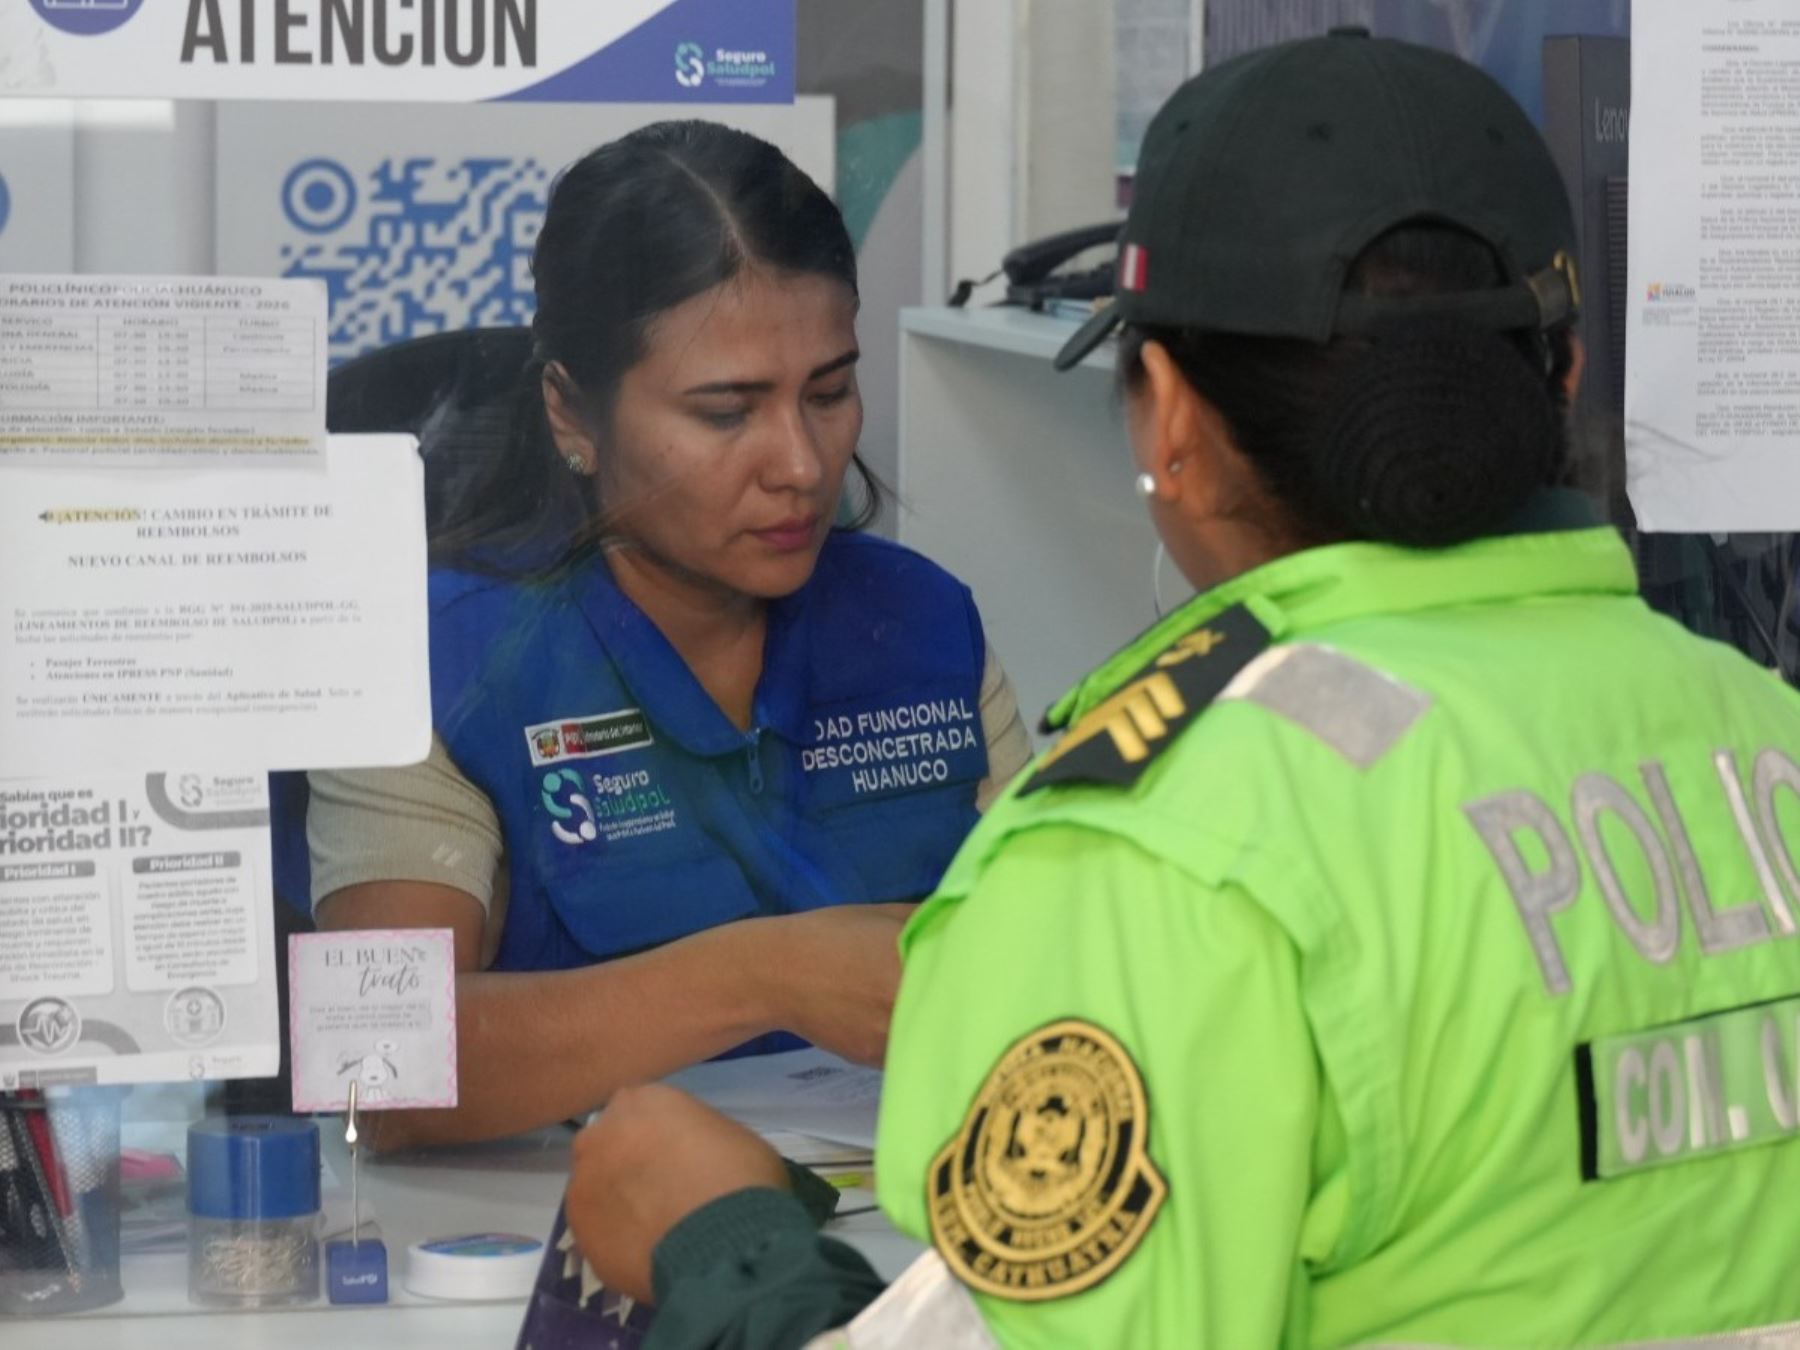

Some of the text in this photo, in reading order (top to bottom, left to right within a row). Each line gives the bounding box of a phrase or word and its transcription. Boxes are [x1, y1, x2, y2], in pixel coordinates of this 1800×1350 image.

[716, 49, 766, 65] Seguro
[707, 61, 775, 80] Saludpol
[94, 297, 170, 310] ATENCIÓN
[151, 507, 215, 521] CAMBIO
[217, 506, 238, 519] EN
[242, 502, 310, 519] TRÁMITE
[313, 503, 334, 517] DE
[136, 525, 240, 540] REEMBOLSOS
[67, 549, 308, 567] NUEVO CANAL DE REEMBOLSOS
[857, 697, 974, 737] FUNCIONAL
[801, 724, 978, 772] DESCONCETRADA
[592, 769, 650, 797] Seguro
[851, 757, 949, 795] HUANUCO
[48, 789, 75, 803] que
[77, 788, 94, 800] es
[3, 862, 69, 881] Prioridad
[149, 854, 213, 872] Prioridad
[325, 946, 415, 967] EL BUEN
[358, 964, 421, 998] trato
